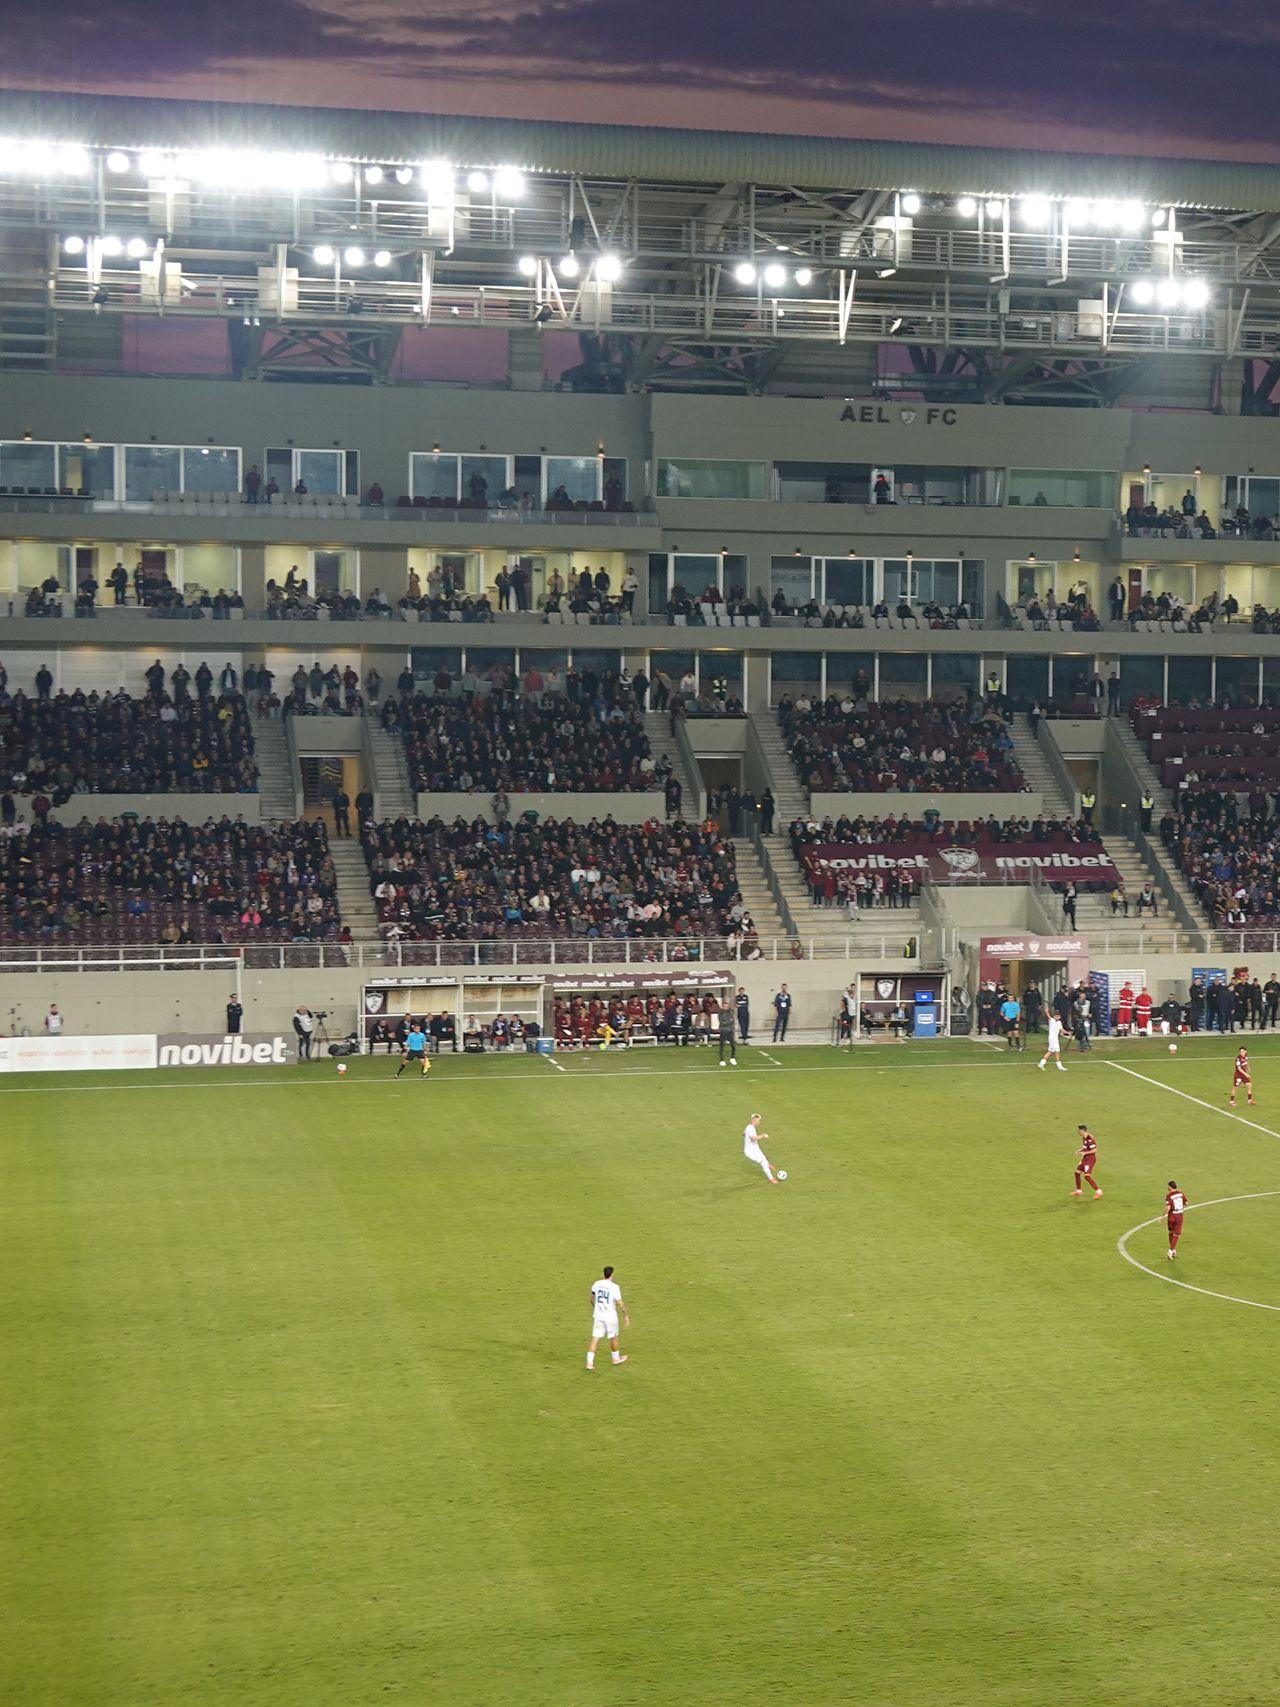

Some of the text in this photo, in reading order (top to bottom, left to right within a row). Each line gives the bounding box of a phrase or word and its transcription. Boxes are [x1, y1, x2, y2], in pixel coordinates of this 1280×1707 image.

[840, 405, 957, 426] AEL FC
[995, 853, 1114, 868] novibet
[986, 941, 1025, 952] novibet
[160, 1036, 287, 1066] novibet
[597, 1289, 610, 1304] 24
